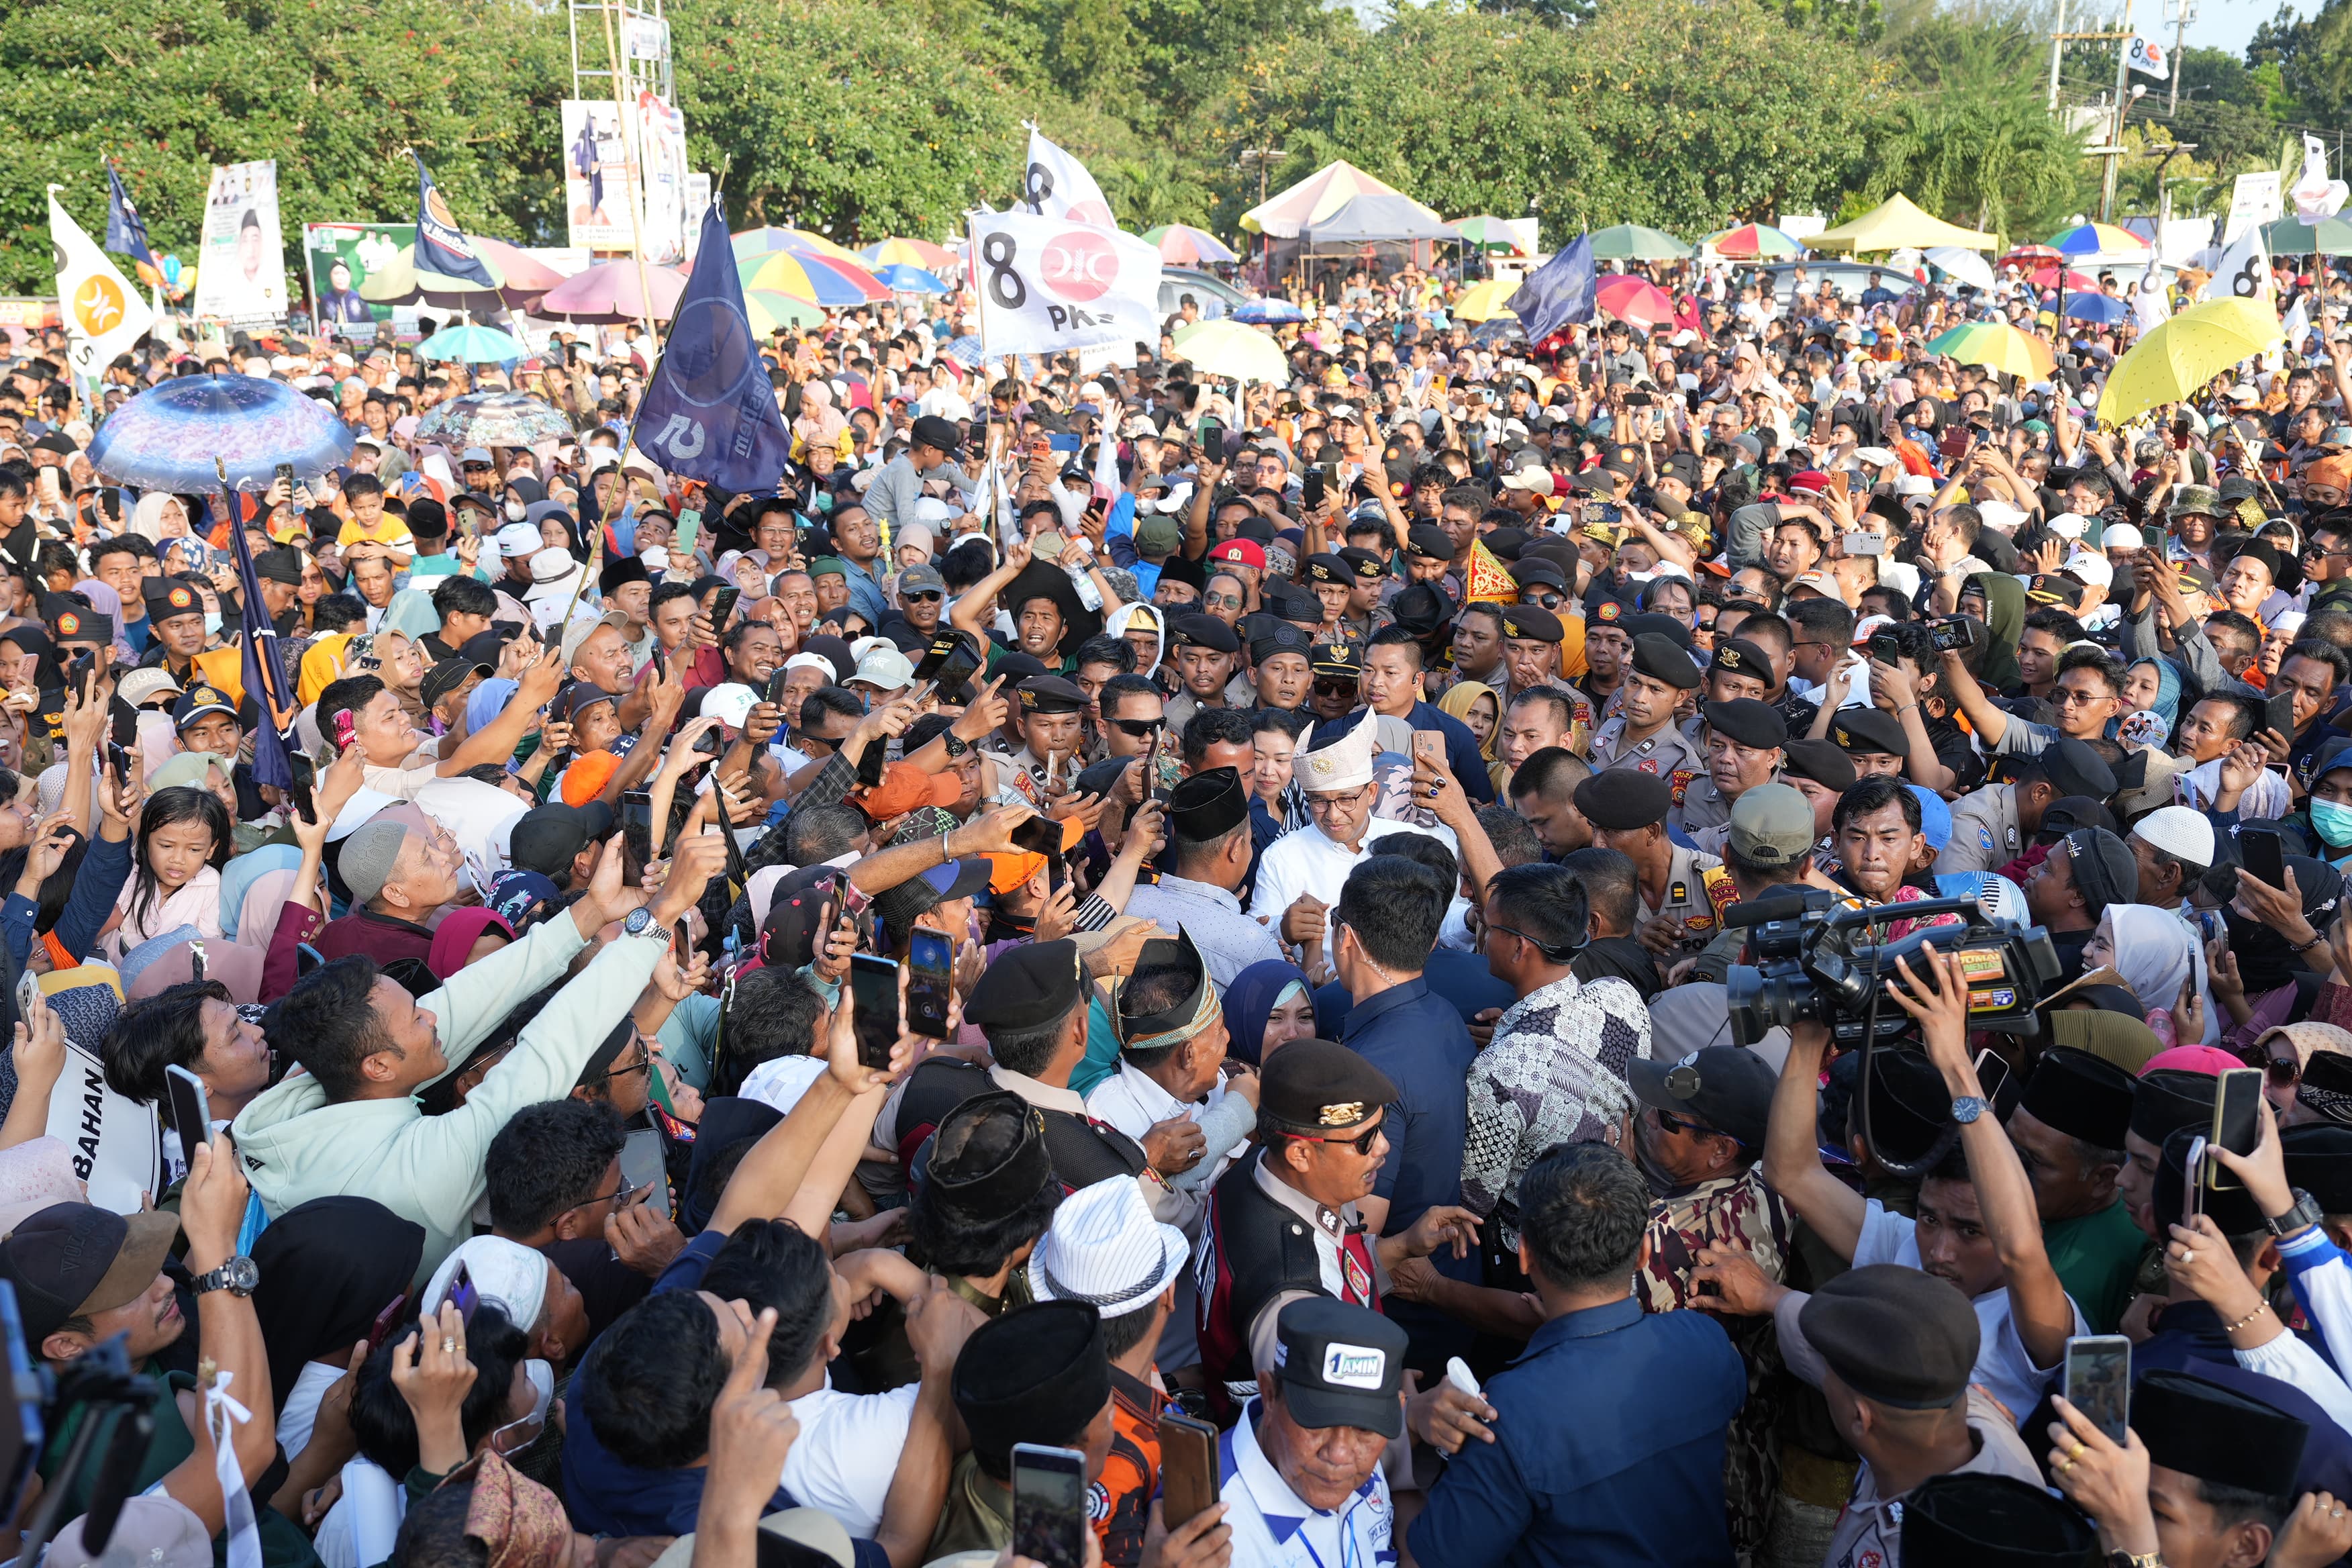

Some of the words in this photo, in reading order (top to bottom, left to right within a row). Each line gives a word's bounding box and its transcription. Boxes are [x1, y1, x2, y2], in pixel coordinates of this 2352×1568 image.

[2130, 38, 2144, 58] 8
[2140, 57, 2158, 69] PKS
[982, 231, 1026, 309] 8
[2233, 254, 2261, 298] 8
[126, 669, 173, 690] GUCC
[1673, 771, 1694, 779] POLRE
[1714, 889, 1735, 897] RIAU
